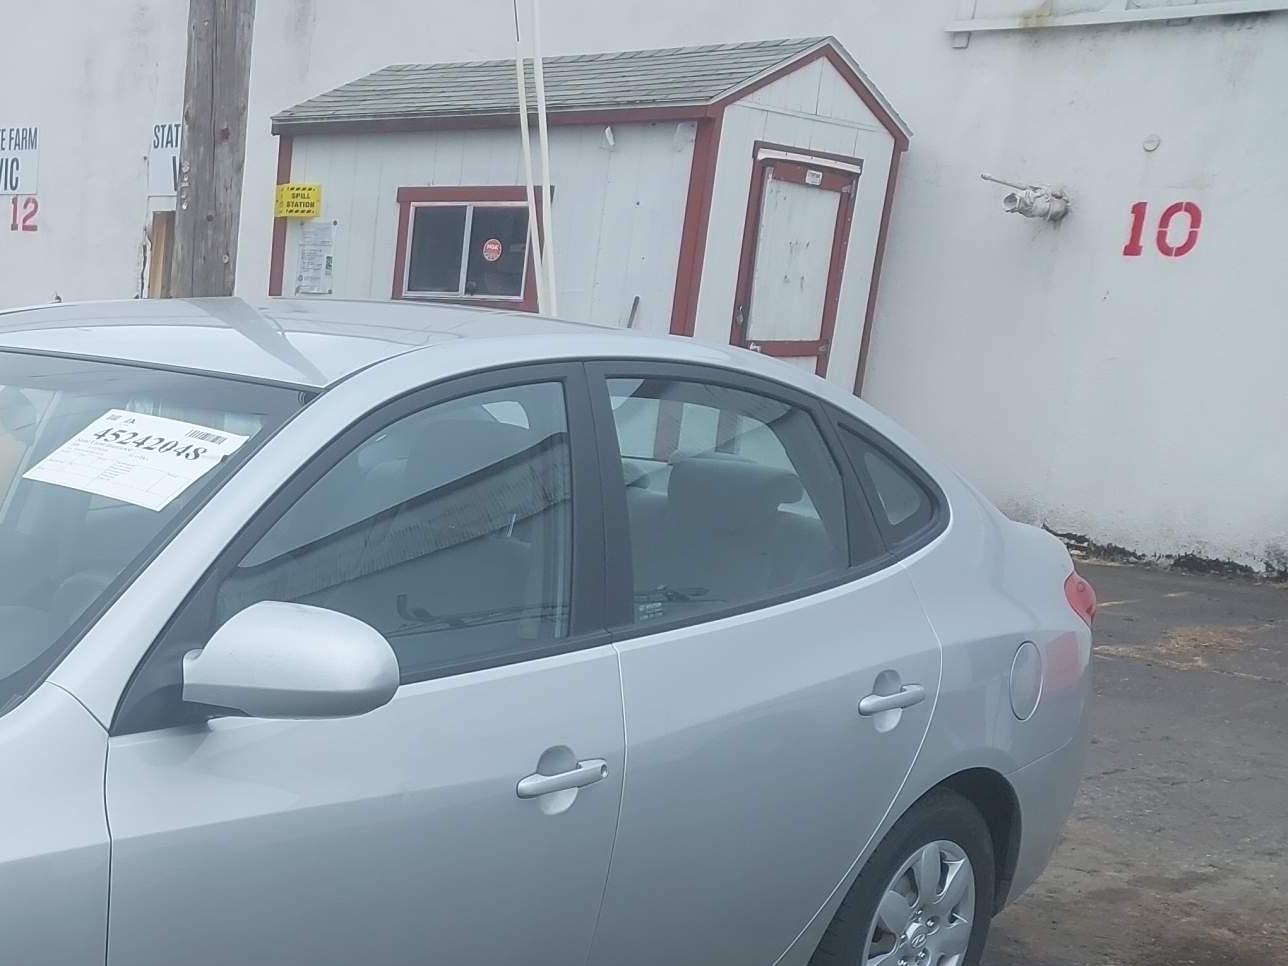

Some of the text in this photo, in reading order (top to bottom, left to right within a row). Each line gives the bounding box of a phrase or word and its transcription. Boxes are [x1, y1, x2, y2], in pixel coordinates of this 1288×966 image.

[9, 128, 37, 150] FARM
[153, 124, 182, 149] STAT
[10, 196, 39, 231] 12
[1122, 201, 1202, 257] 10
